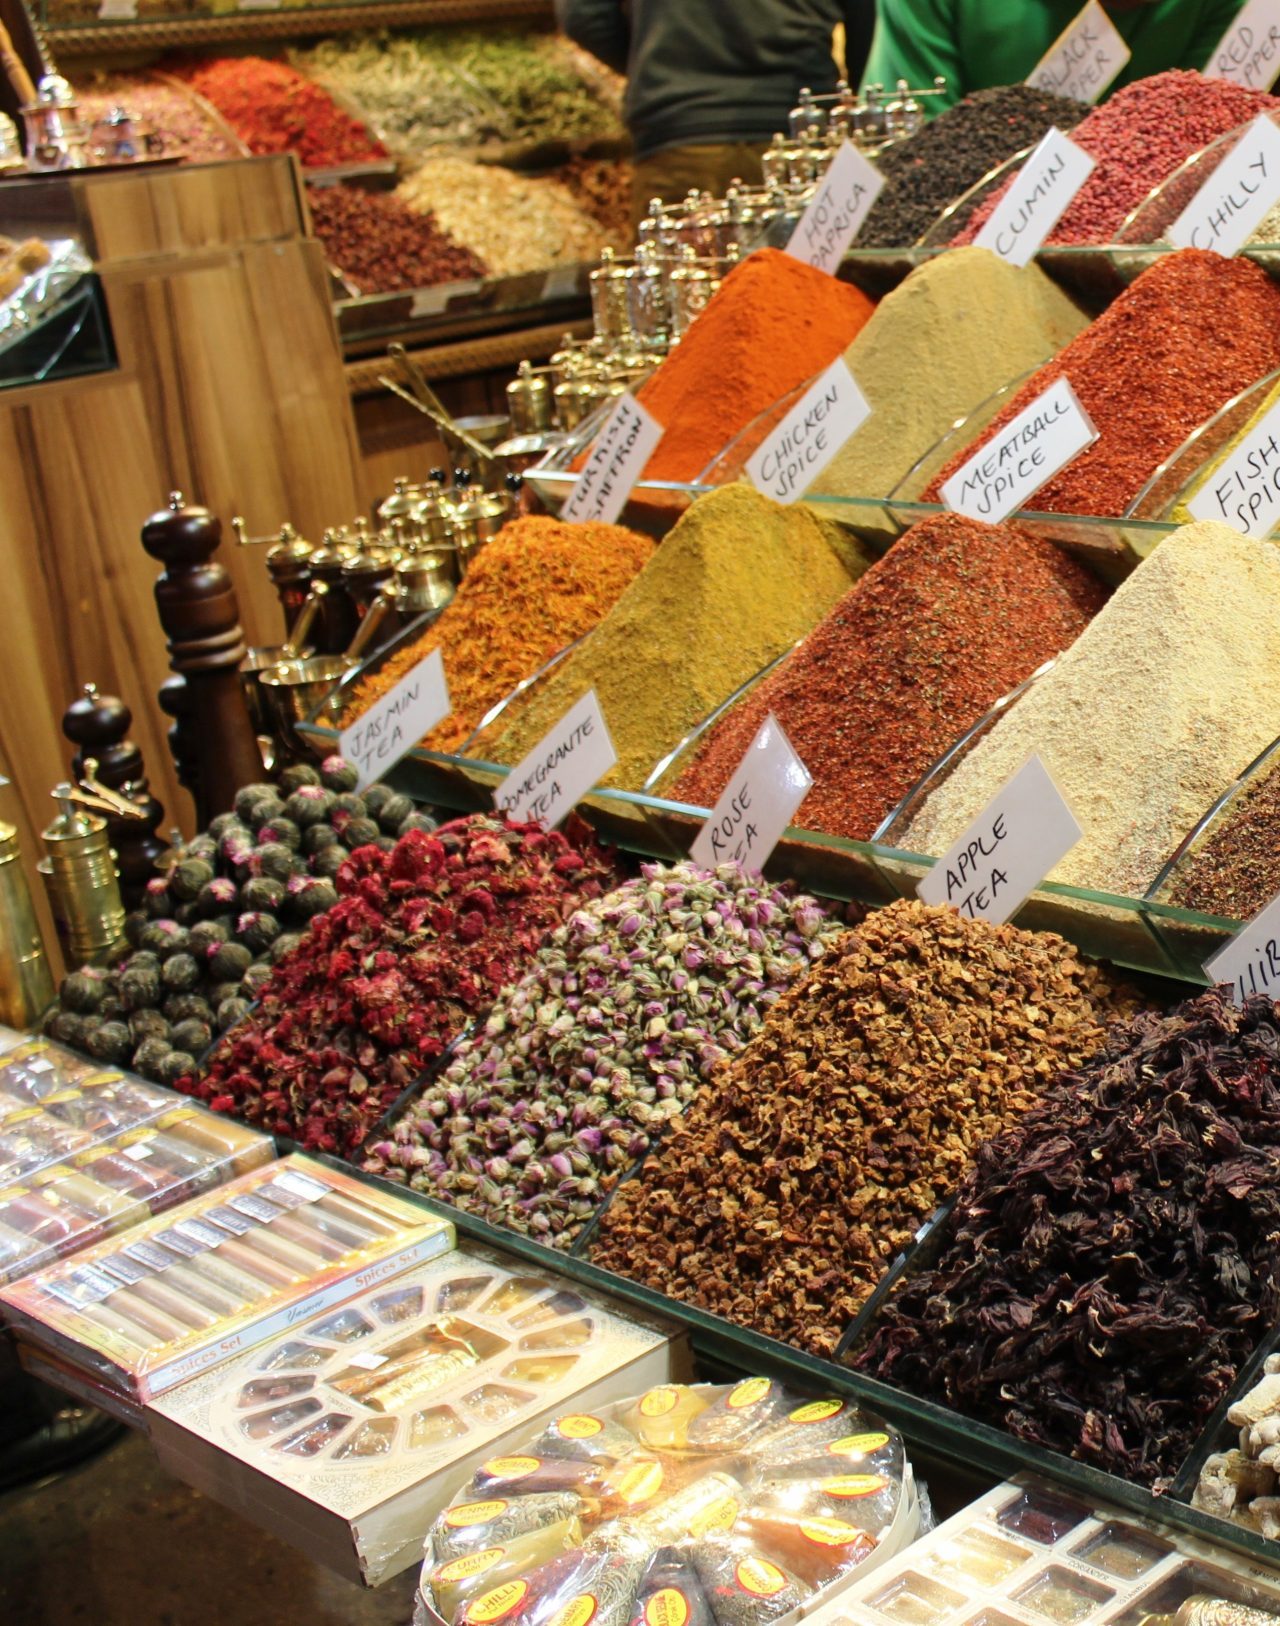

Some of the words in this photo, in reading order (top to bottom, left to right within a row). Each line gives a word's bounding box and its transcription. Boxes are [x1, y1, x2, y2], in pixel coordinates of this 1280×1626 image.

[1069, 49, 1111, 99] PPER
[1217, 26, 1254, 77] RED
[803, 185, 835, 249] HOT
[960, 400, 1071, 506] MEATBALL
[1215, 435, 1280, 518] FISH
[360, 725, 402, 773] TEA
[529, 781, 562, 821] TEA
[711, 782, 752, 861] ROSE
[729, 824, 758, 863] EA
[946, 813, 1008, 900] APPLE
[961, 868, 1008, 919] TEA
